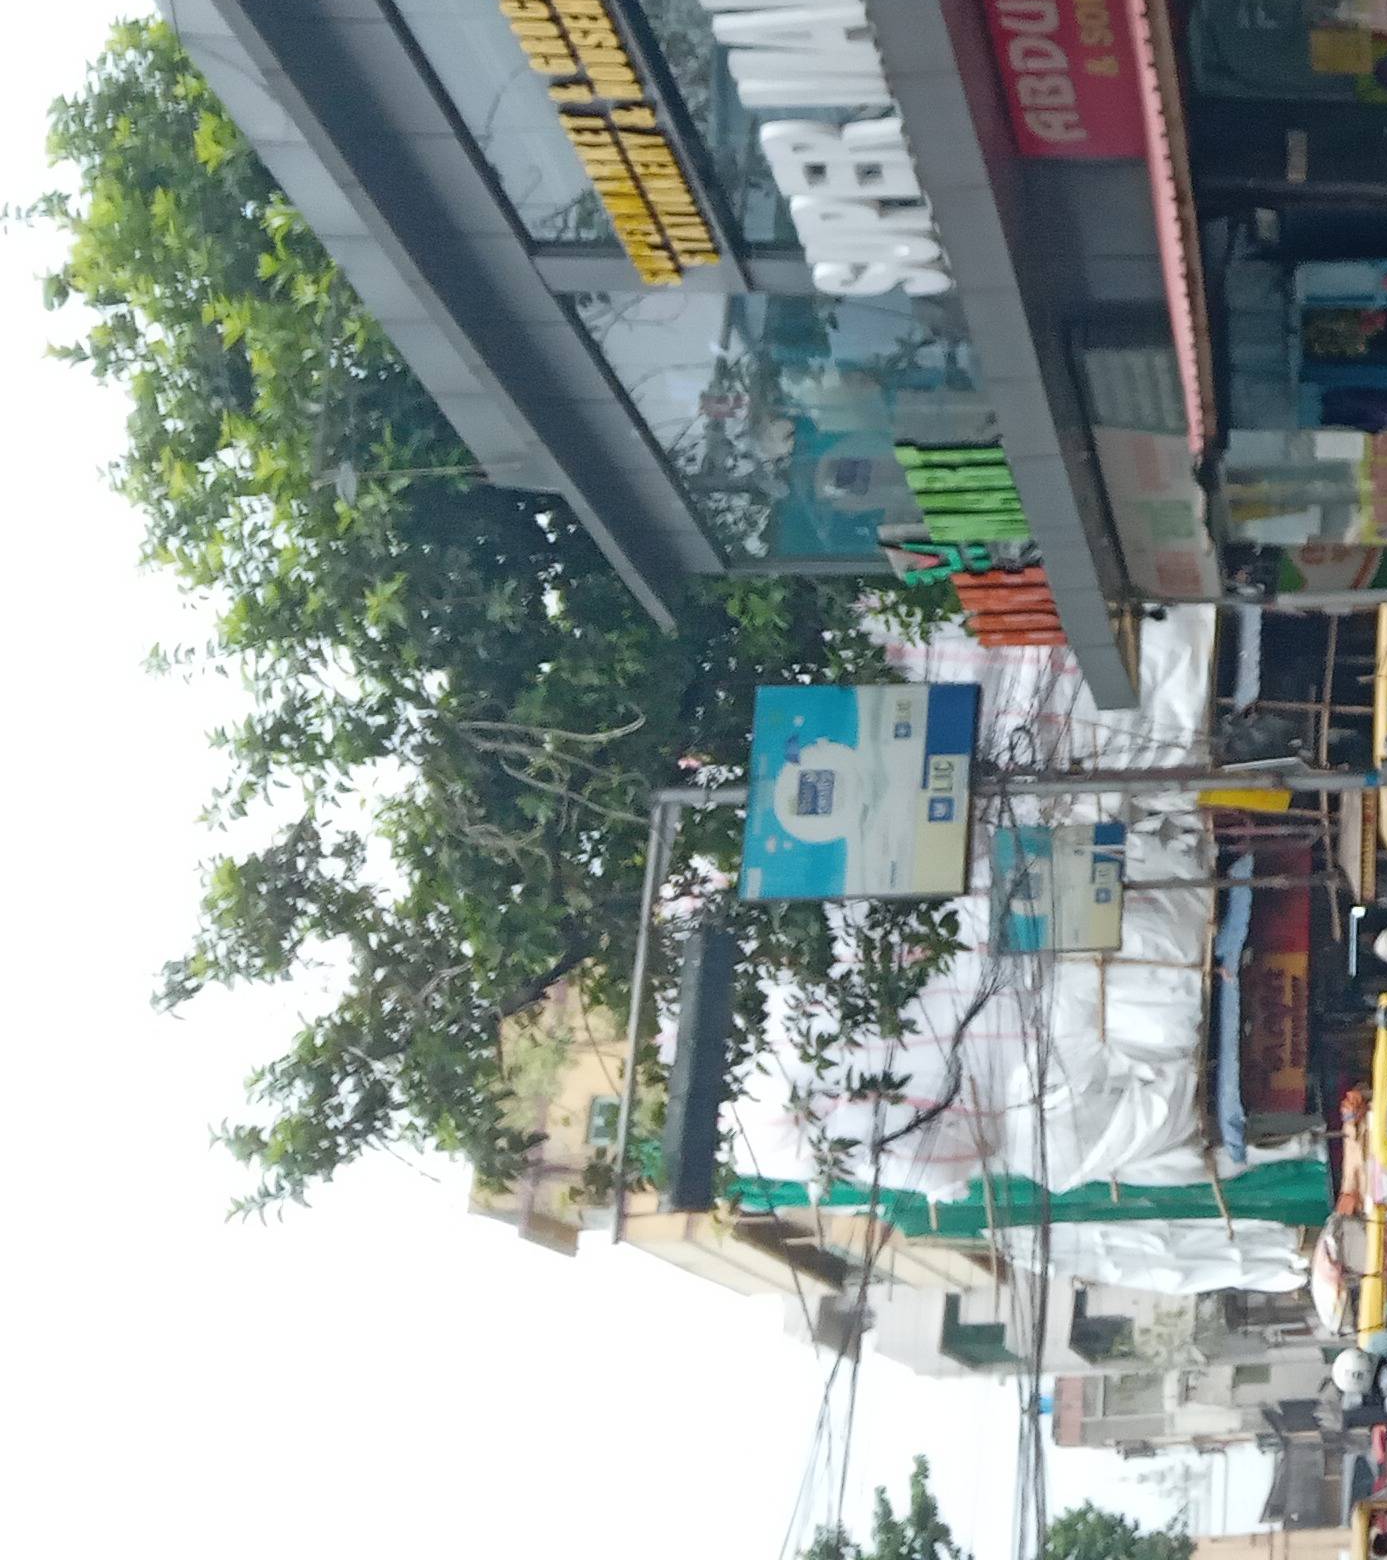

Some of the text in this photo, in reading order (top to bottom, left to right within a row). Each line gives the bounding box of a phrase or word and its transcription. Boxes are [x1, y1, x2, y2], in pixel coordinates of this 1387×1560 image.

[547, 82, 593, 104] &
[1087, 54, 1120, 78] &
[609, 105, 656, 129] &
[558, 111, 683, 286] SUPERMARKET
[615, 129, 720, 267] STATIONERY
[759, 118, 954, 295] SUPER
[893, 444, 1033, 543] MART
[932, 759, 955, 793] LIC
